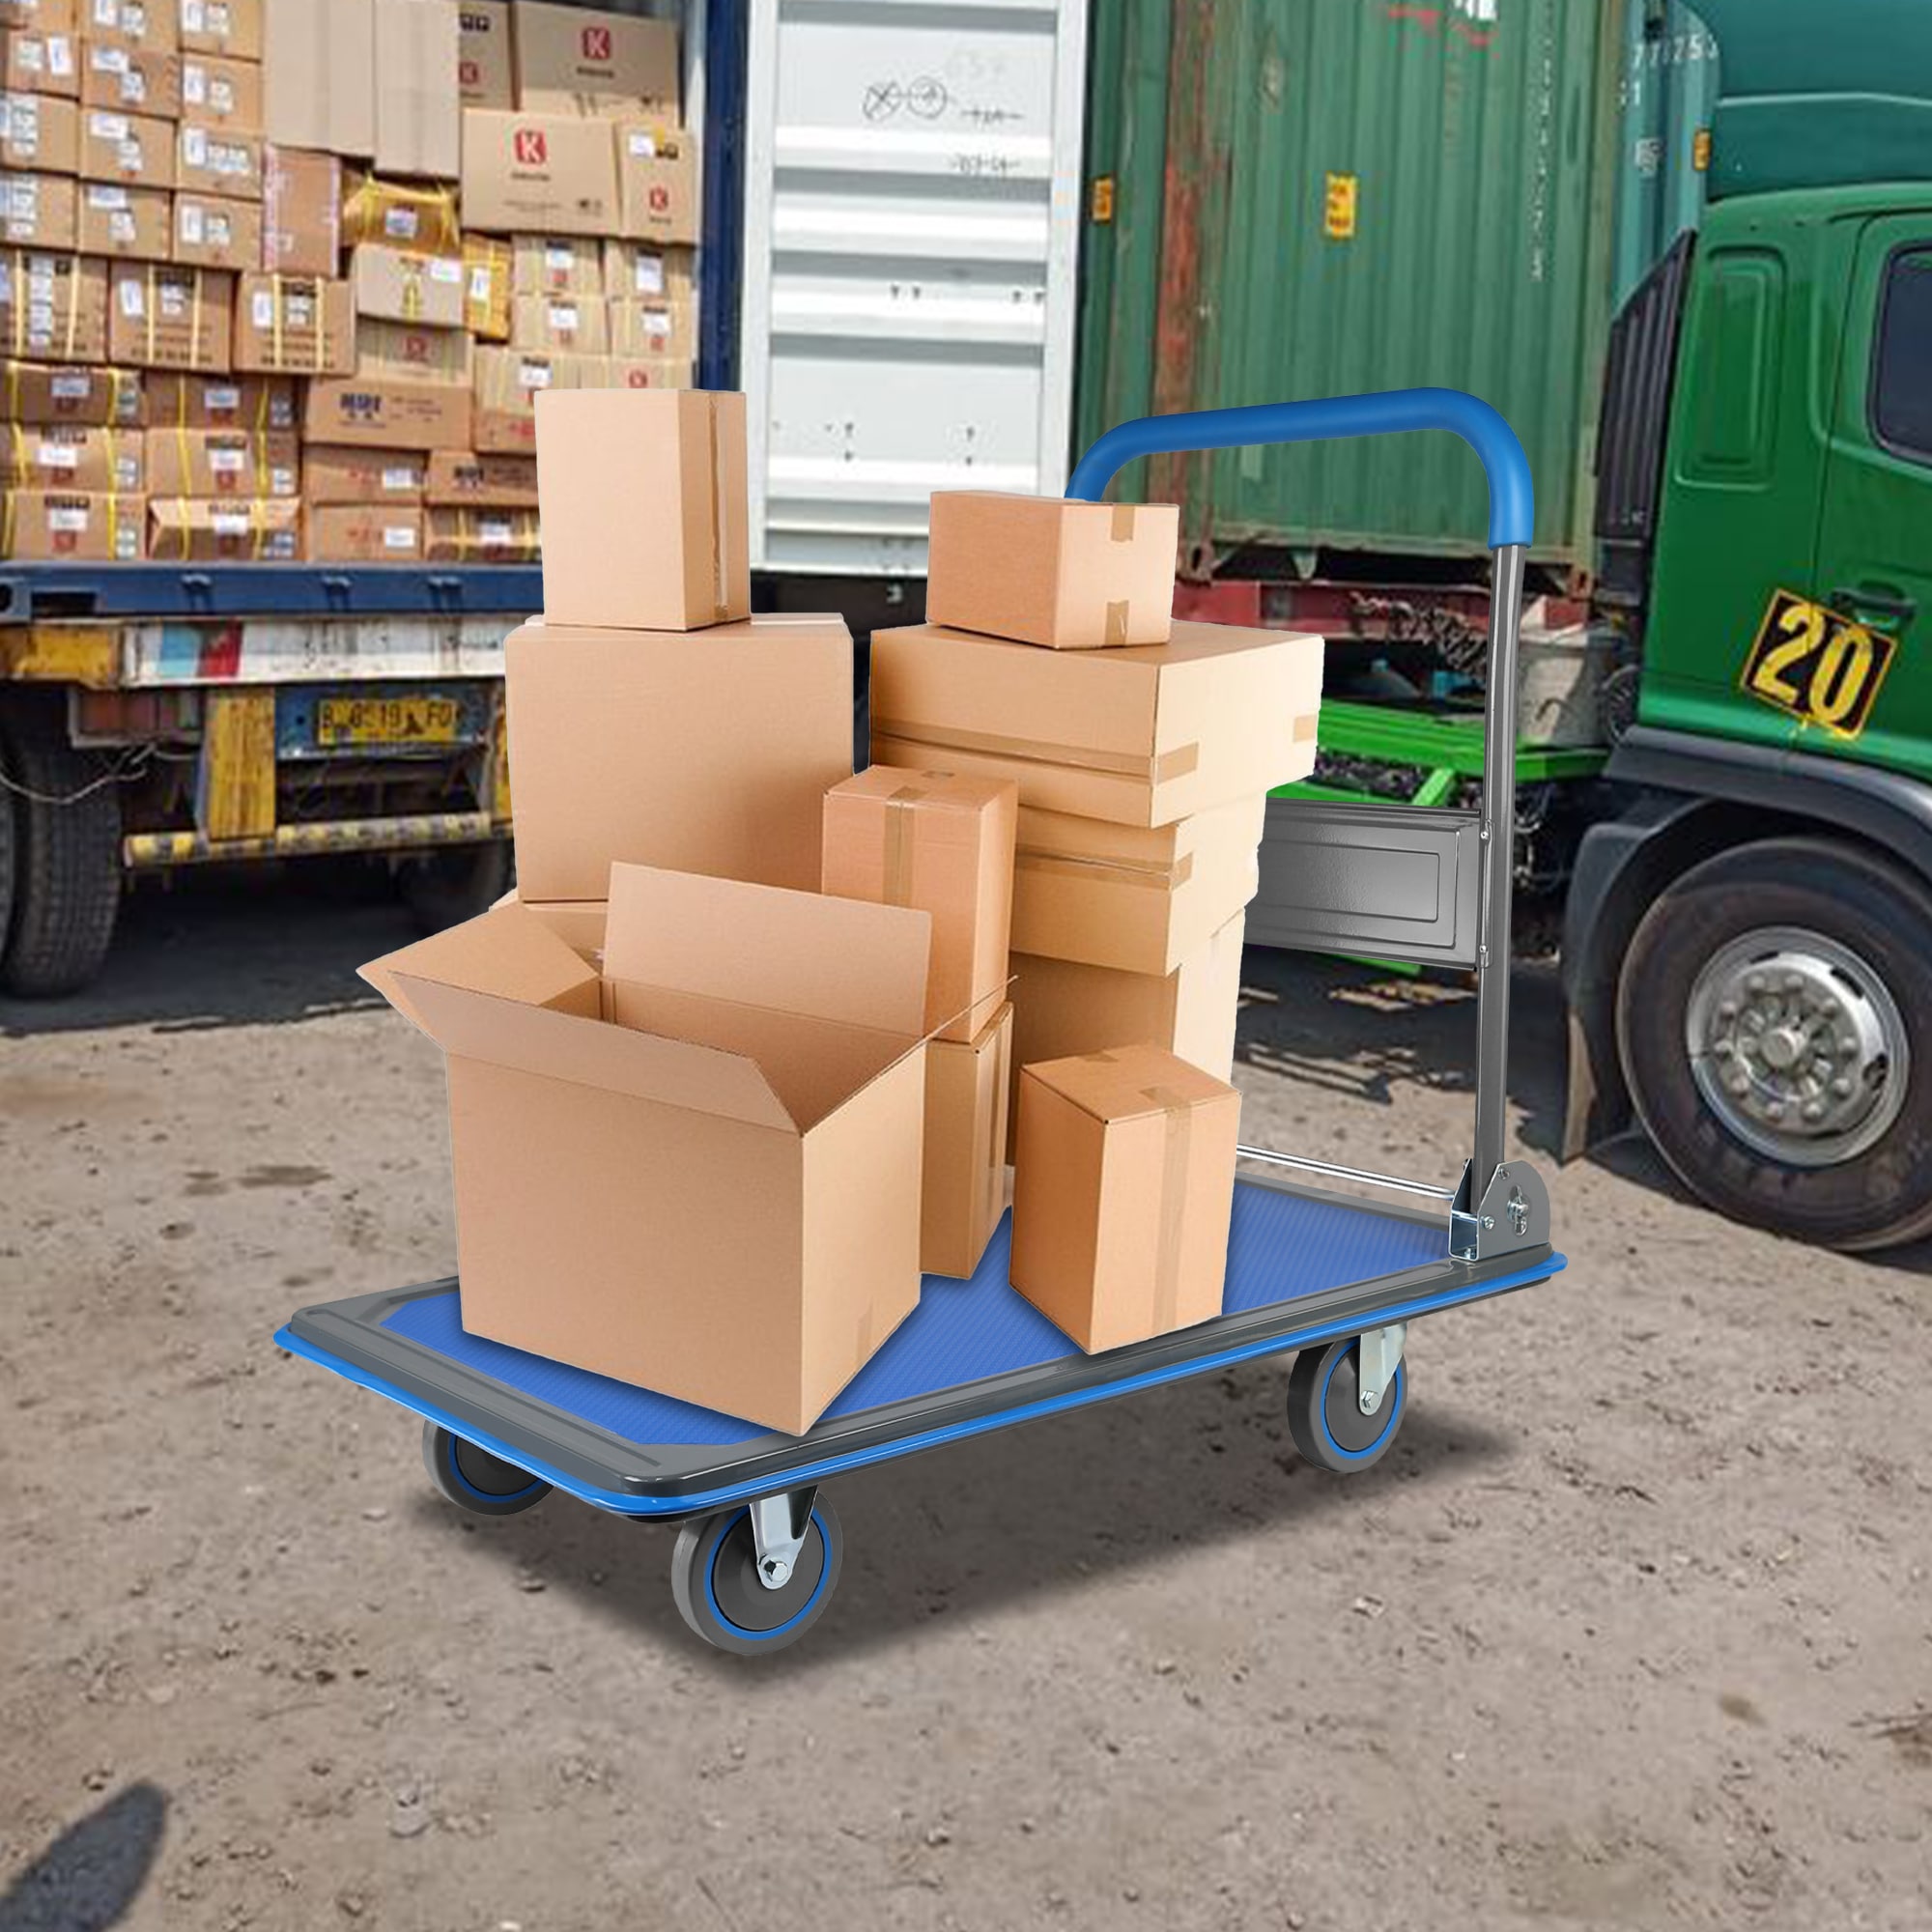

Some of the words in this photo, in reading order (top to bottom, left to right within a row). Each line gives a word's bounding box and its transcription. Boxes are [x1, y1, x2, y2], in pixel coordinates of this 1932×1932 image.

[586, 31, 609, 57] K
[521, 133, 544, 162] K
[1752, 603, 1873, 723] 20
